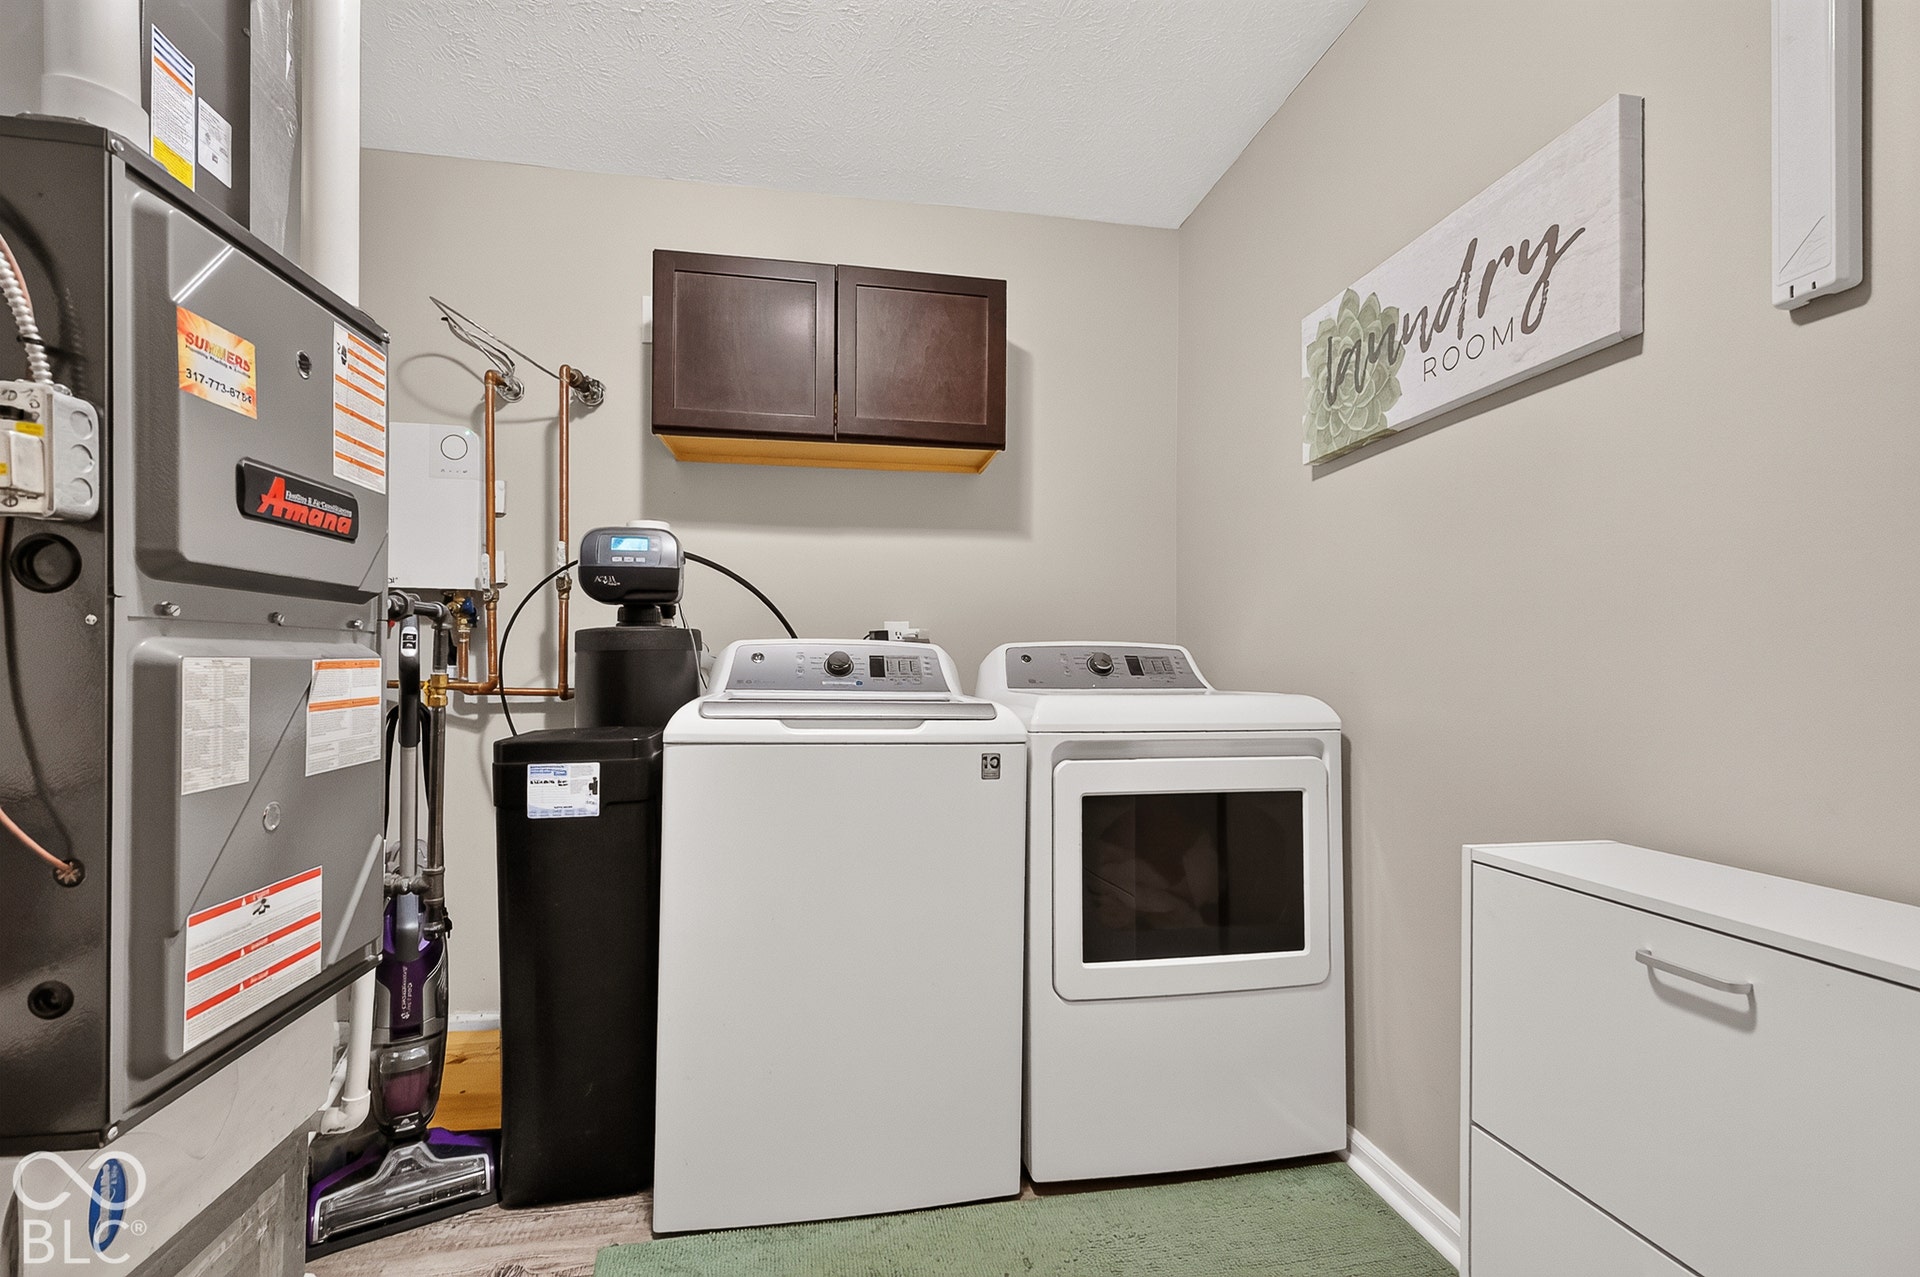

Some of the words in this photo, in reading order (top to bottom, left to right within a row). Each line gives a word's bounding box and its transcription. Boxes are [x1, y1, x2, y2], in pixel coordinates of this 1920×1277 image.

[1326, 224, 1586, 406] laundry
[1423, 317, 1514, 382] ROOM
[257, 476, 353, 535] Amana
